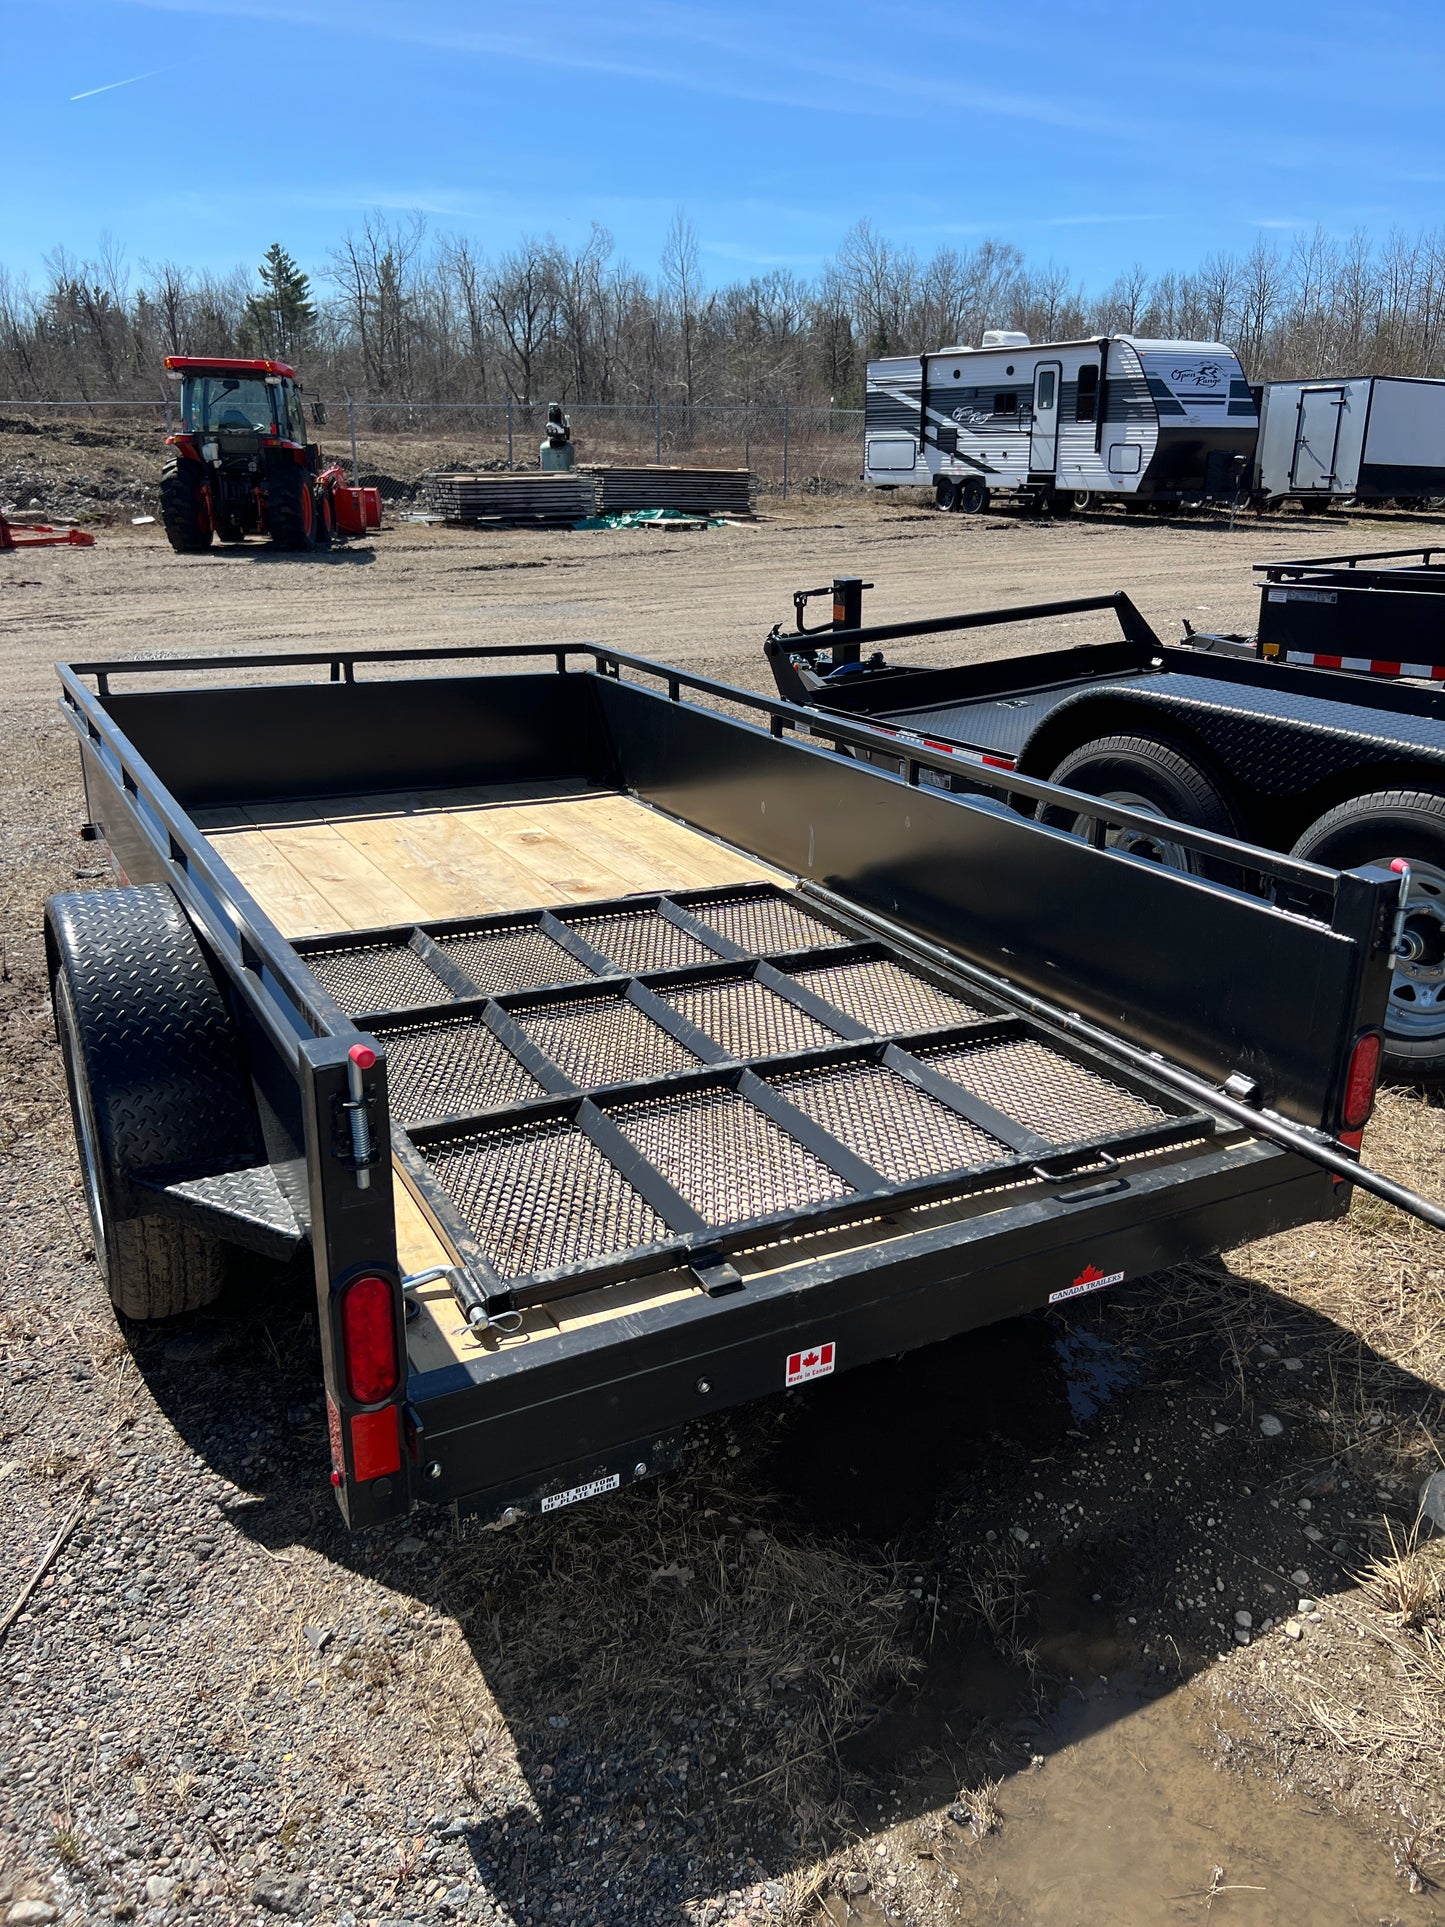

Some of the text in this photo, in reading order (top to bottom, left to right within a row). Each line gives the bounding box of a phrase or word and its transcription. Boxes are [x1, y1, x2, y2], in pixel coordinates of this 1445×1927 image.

[1171, 369, 1221, 388] Open Range
[1052, 1273, 1122, 1300] CANADA TRAILERS
[788, 1375, 803, 1383] Made
[812, 1366, 832, 1375] Canada
[544, 1481, 618, 1510] OF PLATE HERE
[548, 1476, 614, 1503] BOLT BOTTOM
